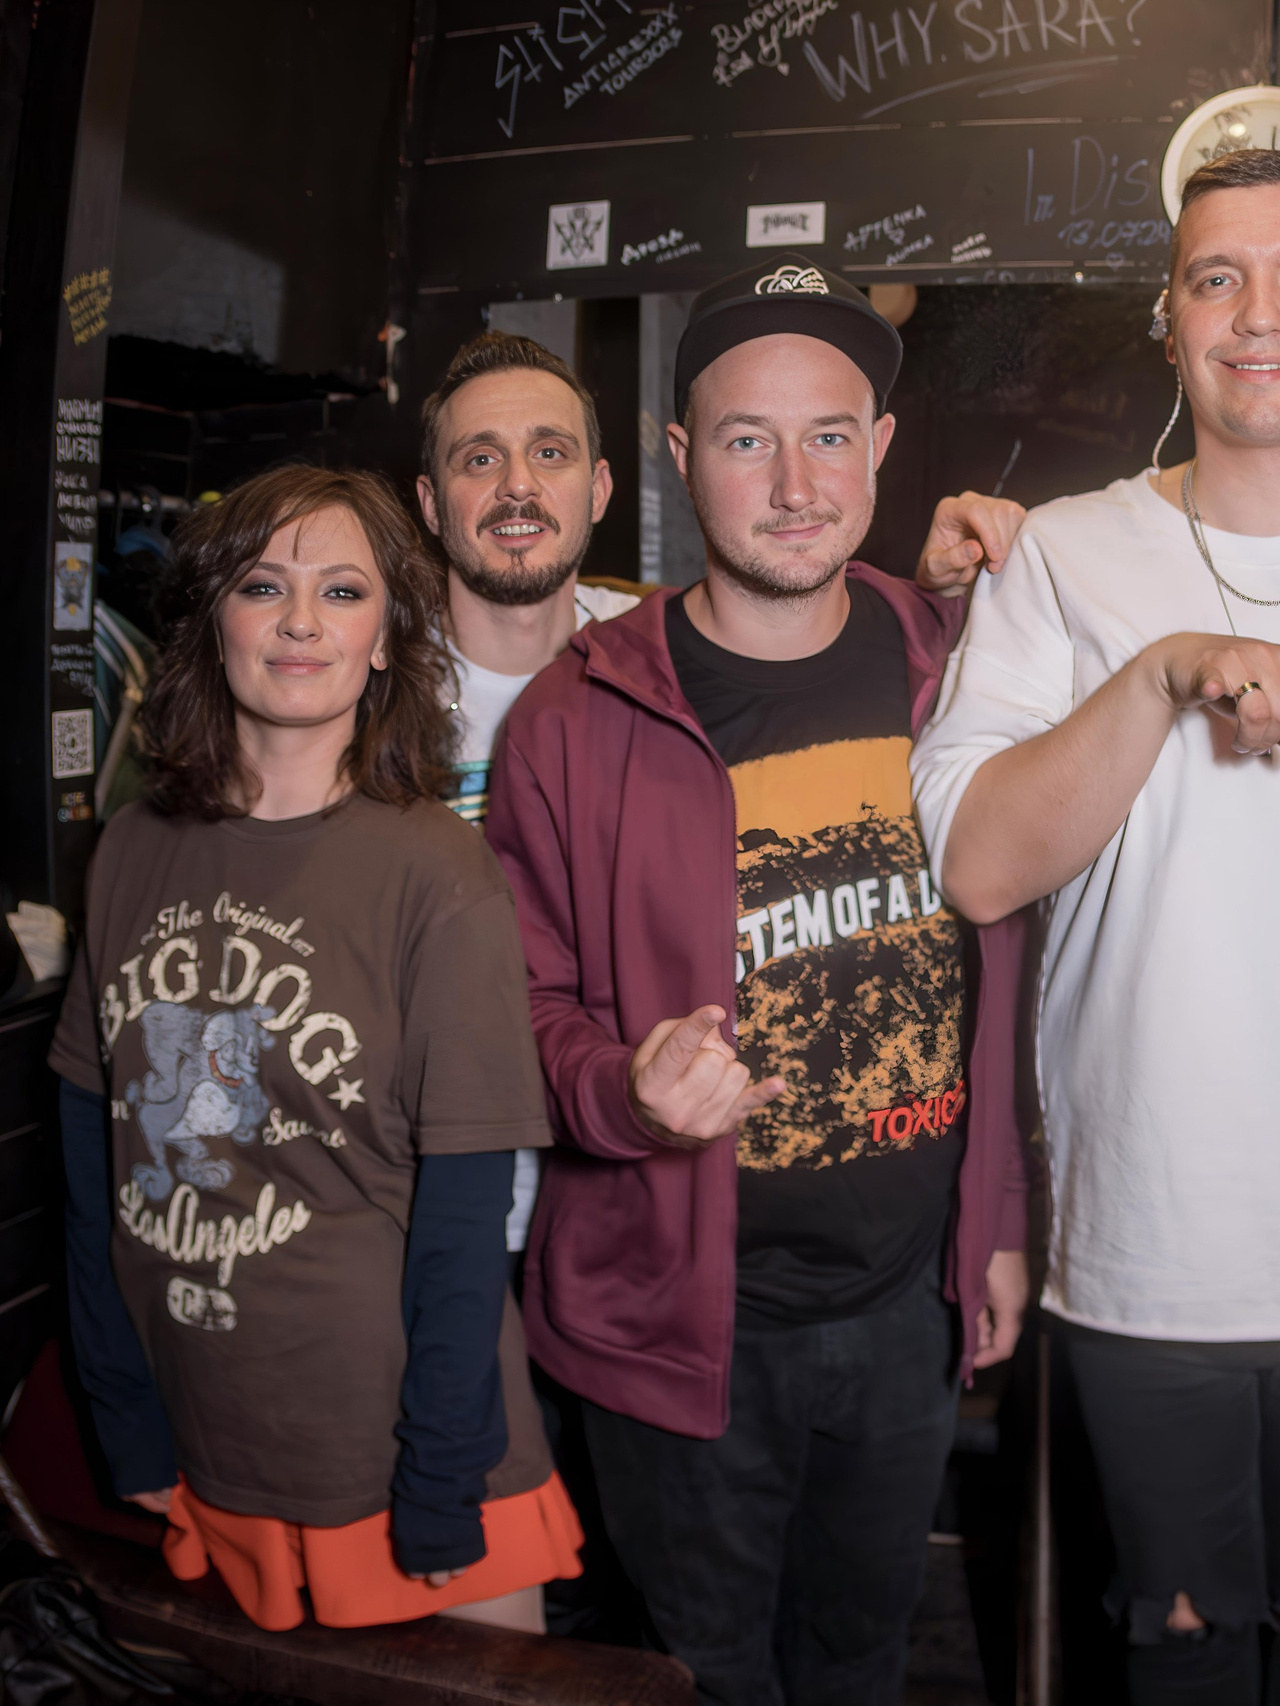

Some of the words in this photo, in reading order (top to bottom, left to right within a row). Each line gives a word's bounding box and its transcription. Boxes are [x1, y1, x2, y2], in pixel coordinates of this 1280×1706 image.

[954, 0, 1143, 63] SARA?
[157, 900, 204, 940] The
[212, 890, 306, 946] Original
[209, 935, 362, 1086] DOG
[166, 1182, 312, 1288] Angeles
